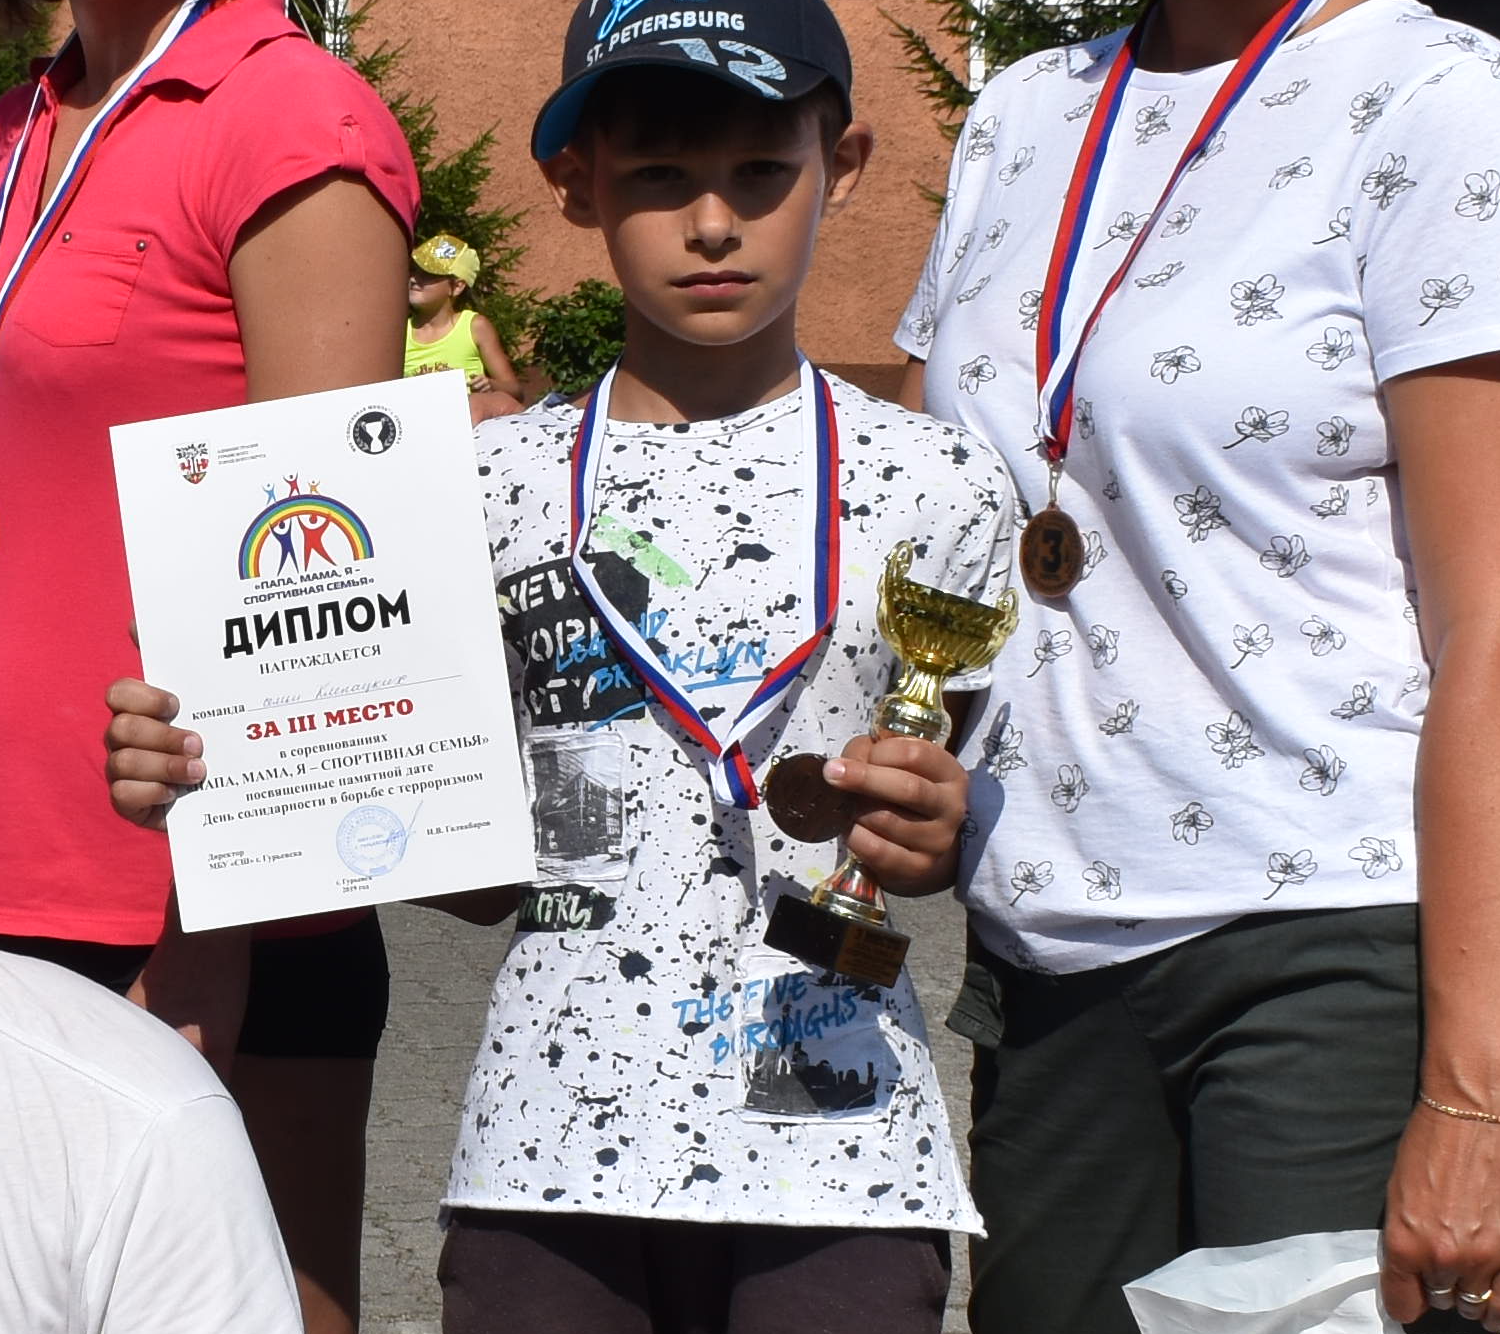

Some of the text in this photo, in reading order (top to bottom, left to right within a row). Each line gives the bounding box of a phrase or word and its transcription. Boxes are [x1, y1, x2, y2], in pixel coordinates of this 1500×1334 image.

[587, 11, 744, 67] ST. PETERSBURG
[658, 38, 787, 100] 12
[1042, 530, 1064, 572] 3
[243, 584, 324, 605] СПОРТИВНАЯ
[300, 567, 353, 583] МАМА, Я
[223, 588, 411, 659] ДИПЛОМ
[260, 644, 381, 675] НАГРАЖДАЕТСЯ
[192, 705, 245, 720] команда
[246, 698, 413, 740] ЗА III МЕСТО
[242, 767, 294, 784] МАМА,
[296, 764, 306, 775] Я
[321, 745, 424, 771] СПОРТИВНАЯ
[428, 734, 489, 753] СЕМЬЯ»
[280, 733, 388, 759] в соревнованиях
[202, 771, 483, 827] День солидарности в борьбе с терроризмом
[246, 763, 434, 803] посвященные памятной дате
[208, 850, 244, 862] Директор
[672, 972, 808, 1028] THE FIVE
